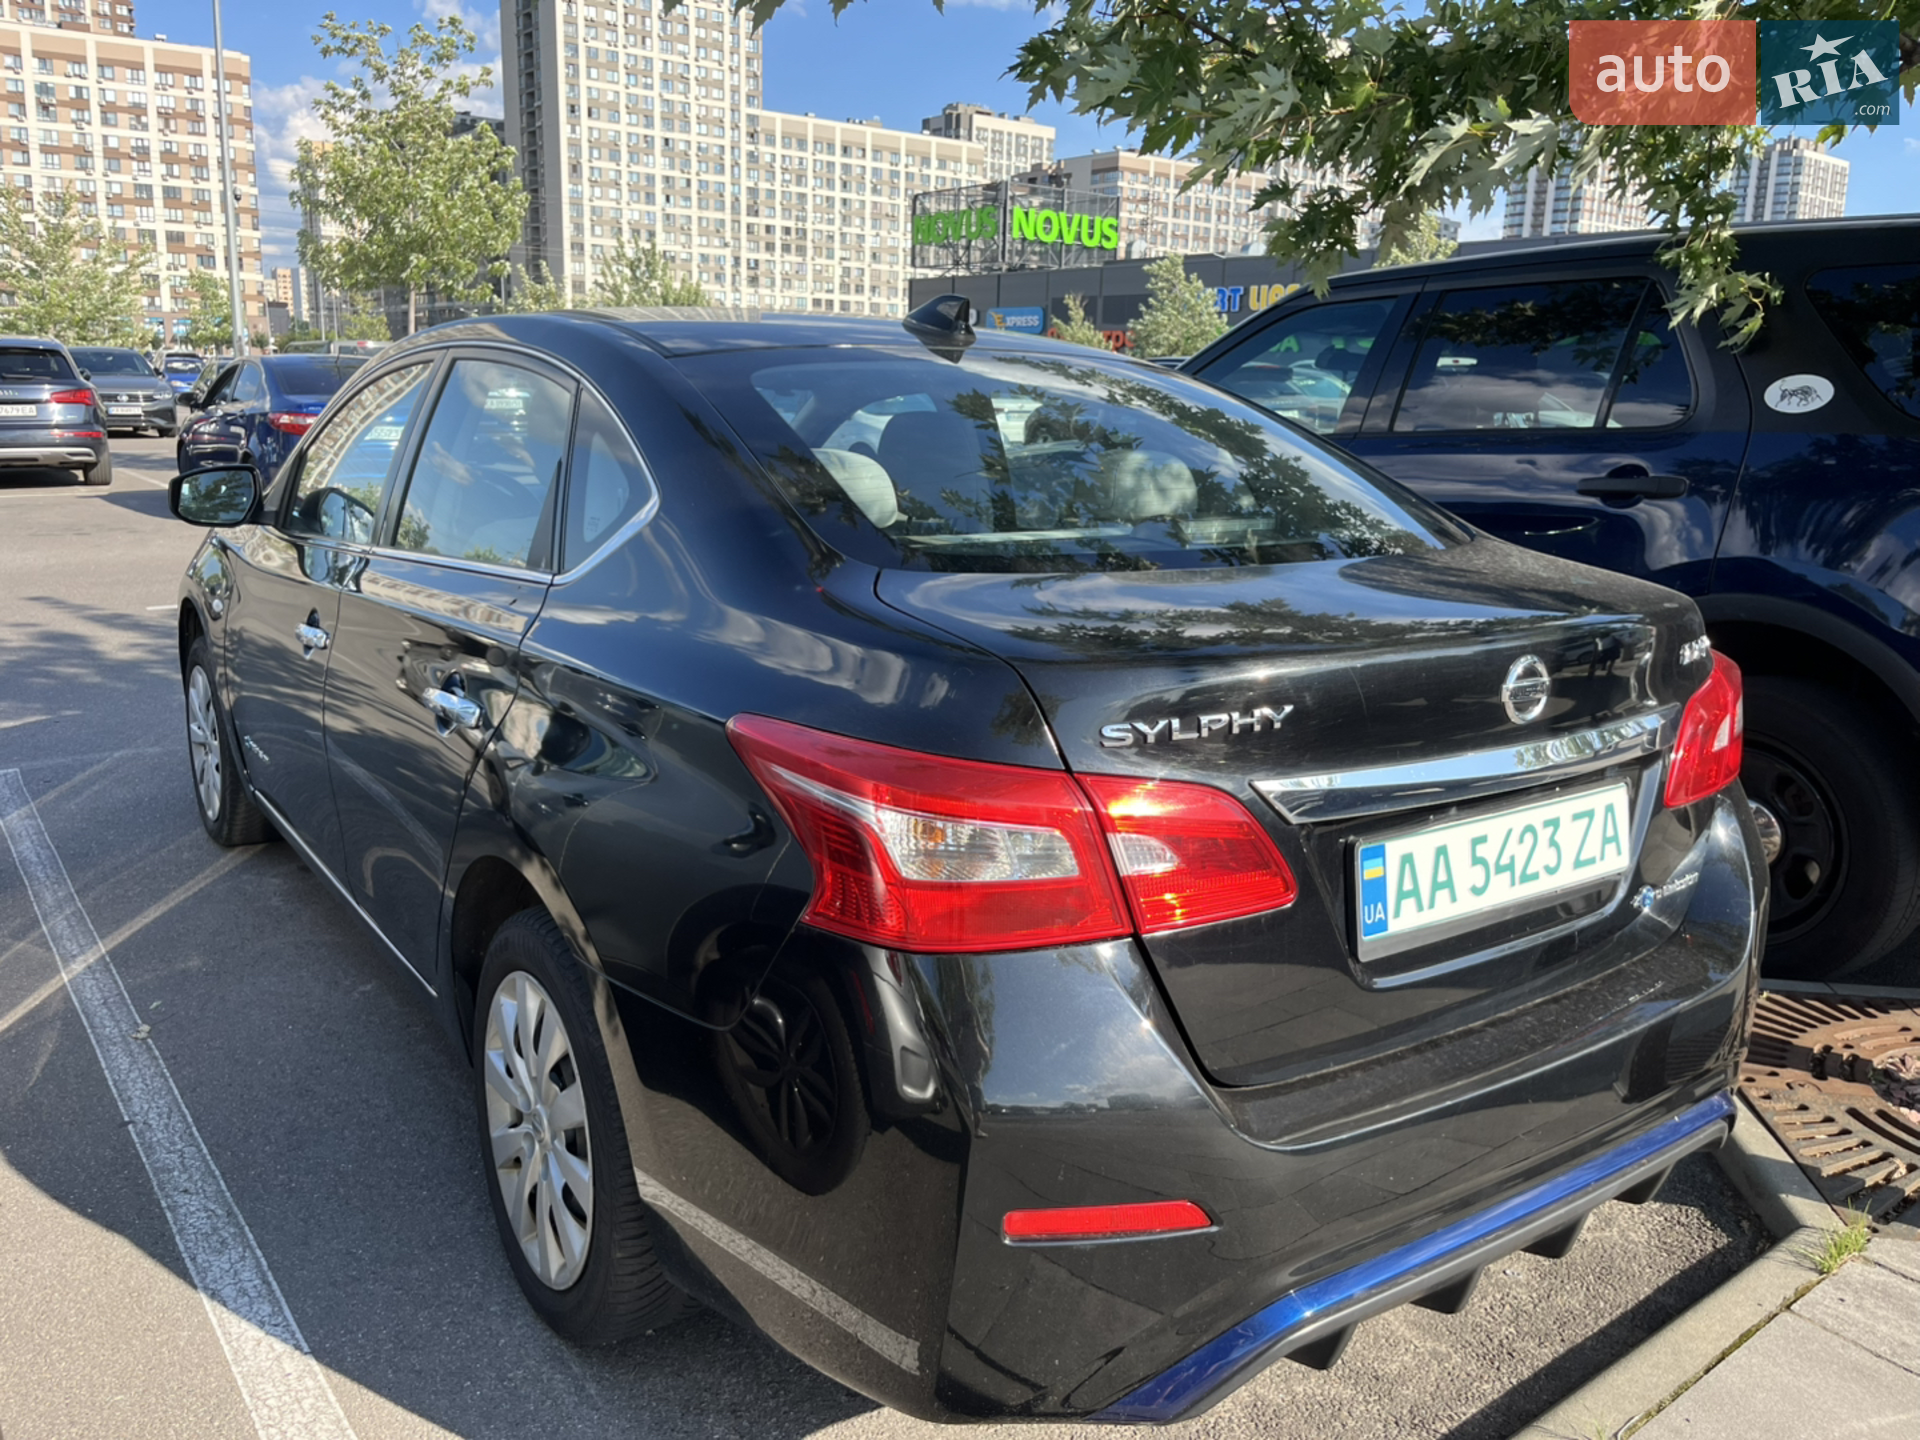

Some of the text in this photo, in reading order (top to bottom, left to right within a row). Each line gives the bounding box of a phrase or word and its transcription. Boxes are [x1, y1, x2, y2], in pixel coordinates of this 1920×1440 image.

[913, 205, 998, 246] NOVUS
[1012, 205, 1119, 249] NOVUS
[992, 314, 1040, 328] EXPRESS
[1100, 704, 1295, 748] SYLPHY
[1392, 843, 1458, 920] AA
[1468, 816, 1562, 897] 5423
[1571, 802, 1622, 870] ZA
[1364, 902, 1386, 924] UA
